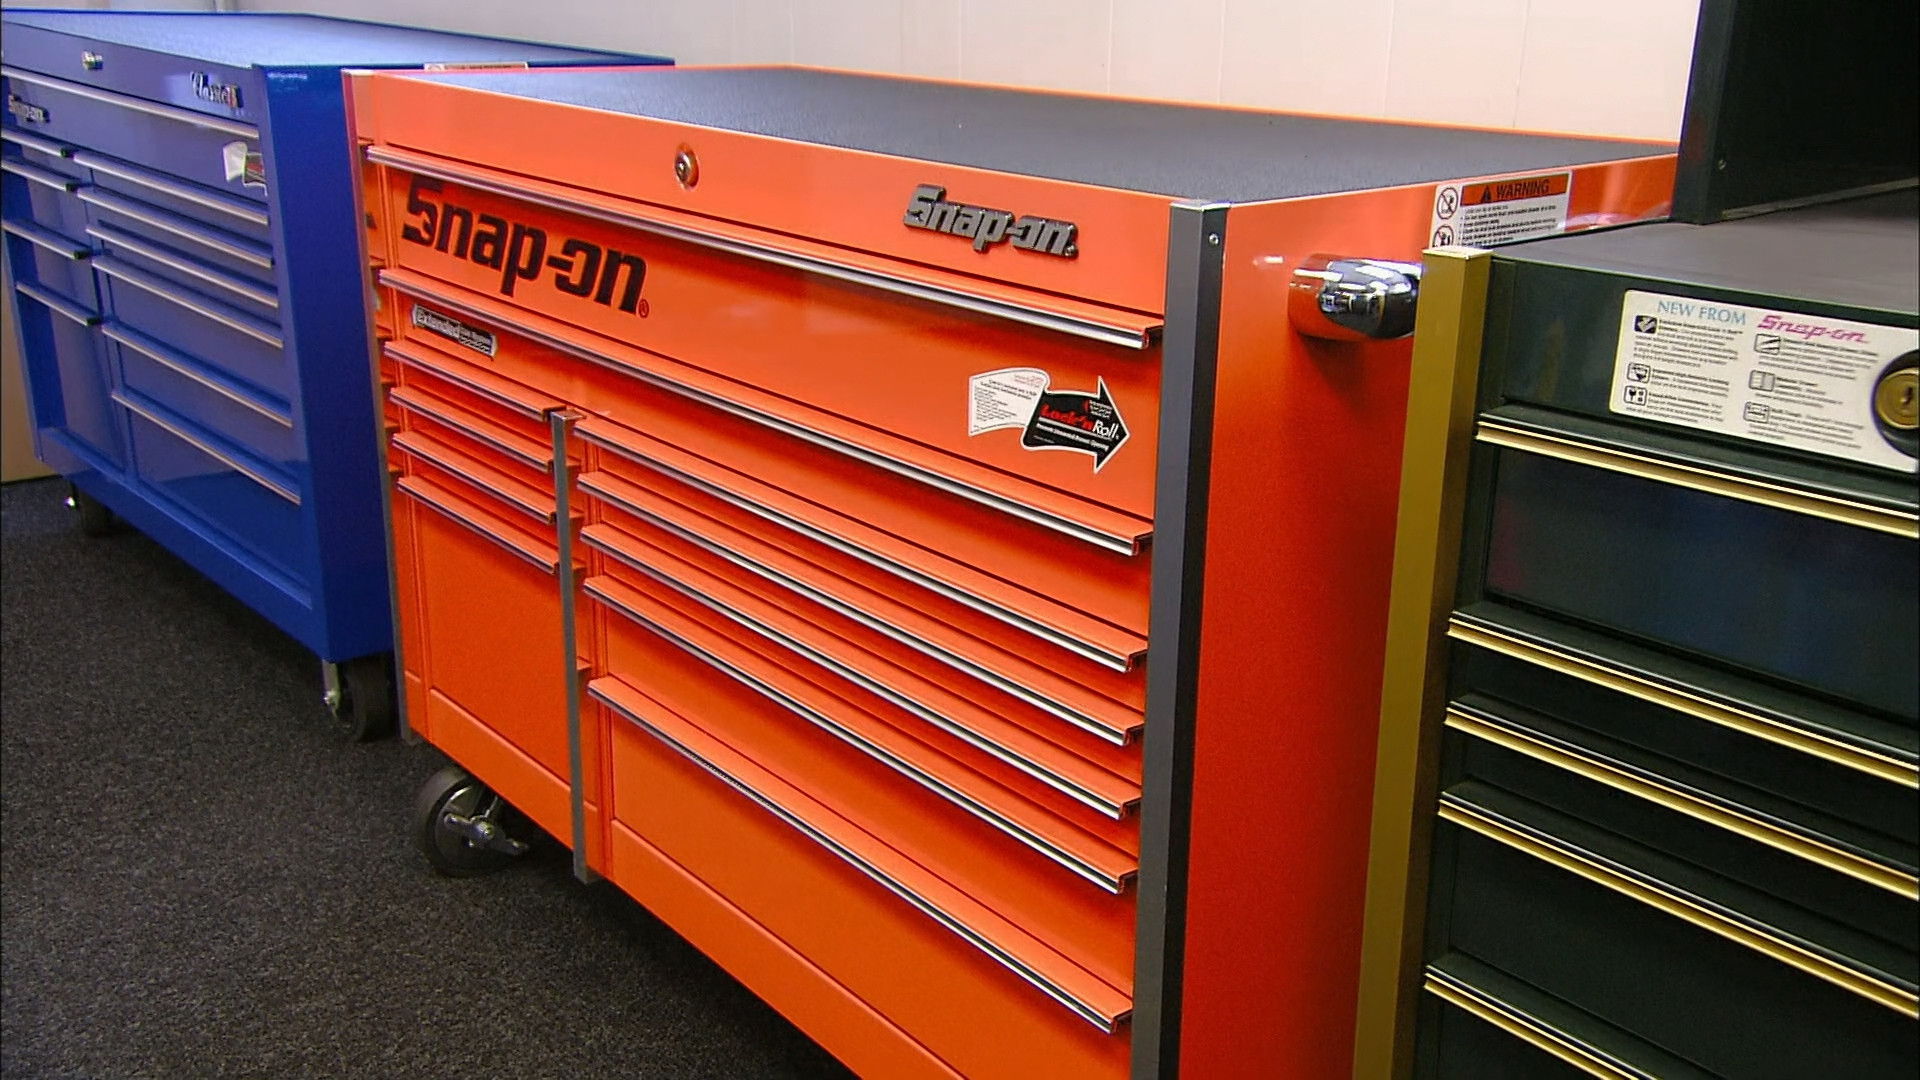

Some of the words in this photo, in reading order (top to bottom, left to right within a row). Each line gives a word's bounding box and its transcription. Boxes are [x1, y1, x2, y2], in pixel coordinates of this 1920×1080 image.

[1497, 180, 1550, 198] WARNING
[402, 175, 647, 315] Snap-on
[1657, 300, 1695, 317] NEW
[1699, 306, 1746, 325] FROM
[1757, 315, 1869, 344] Snap-on
